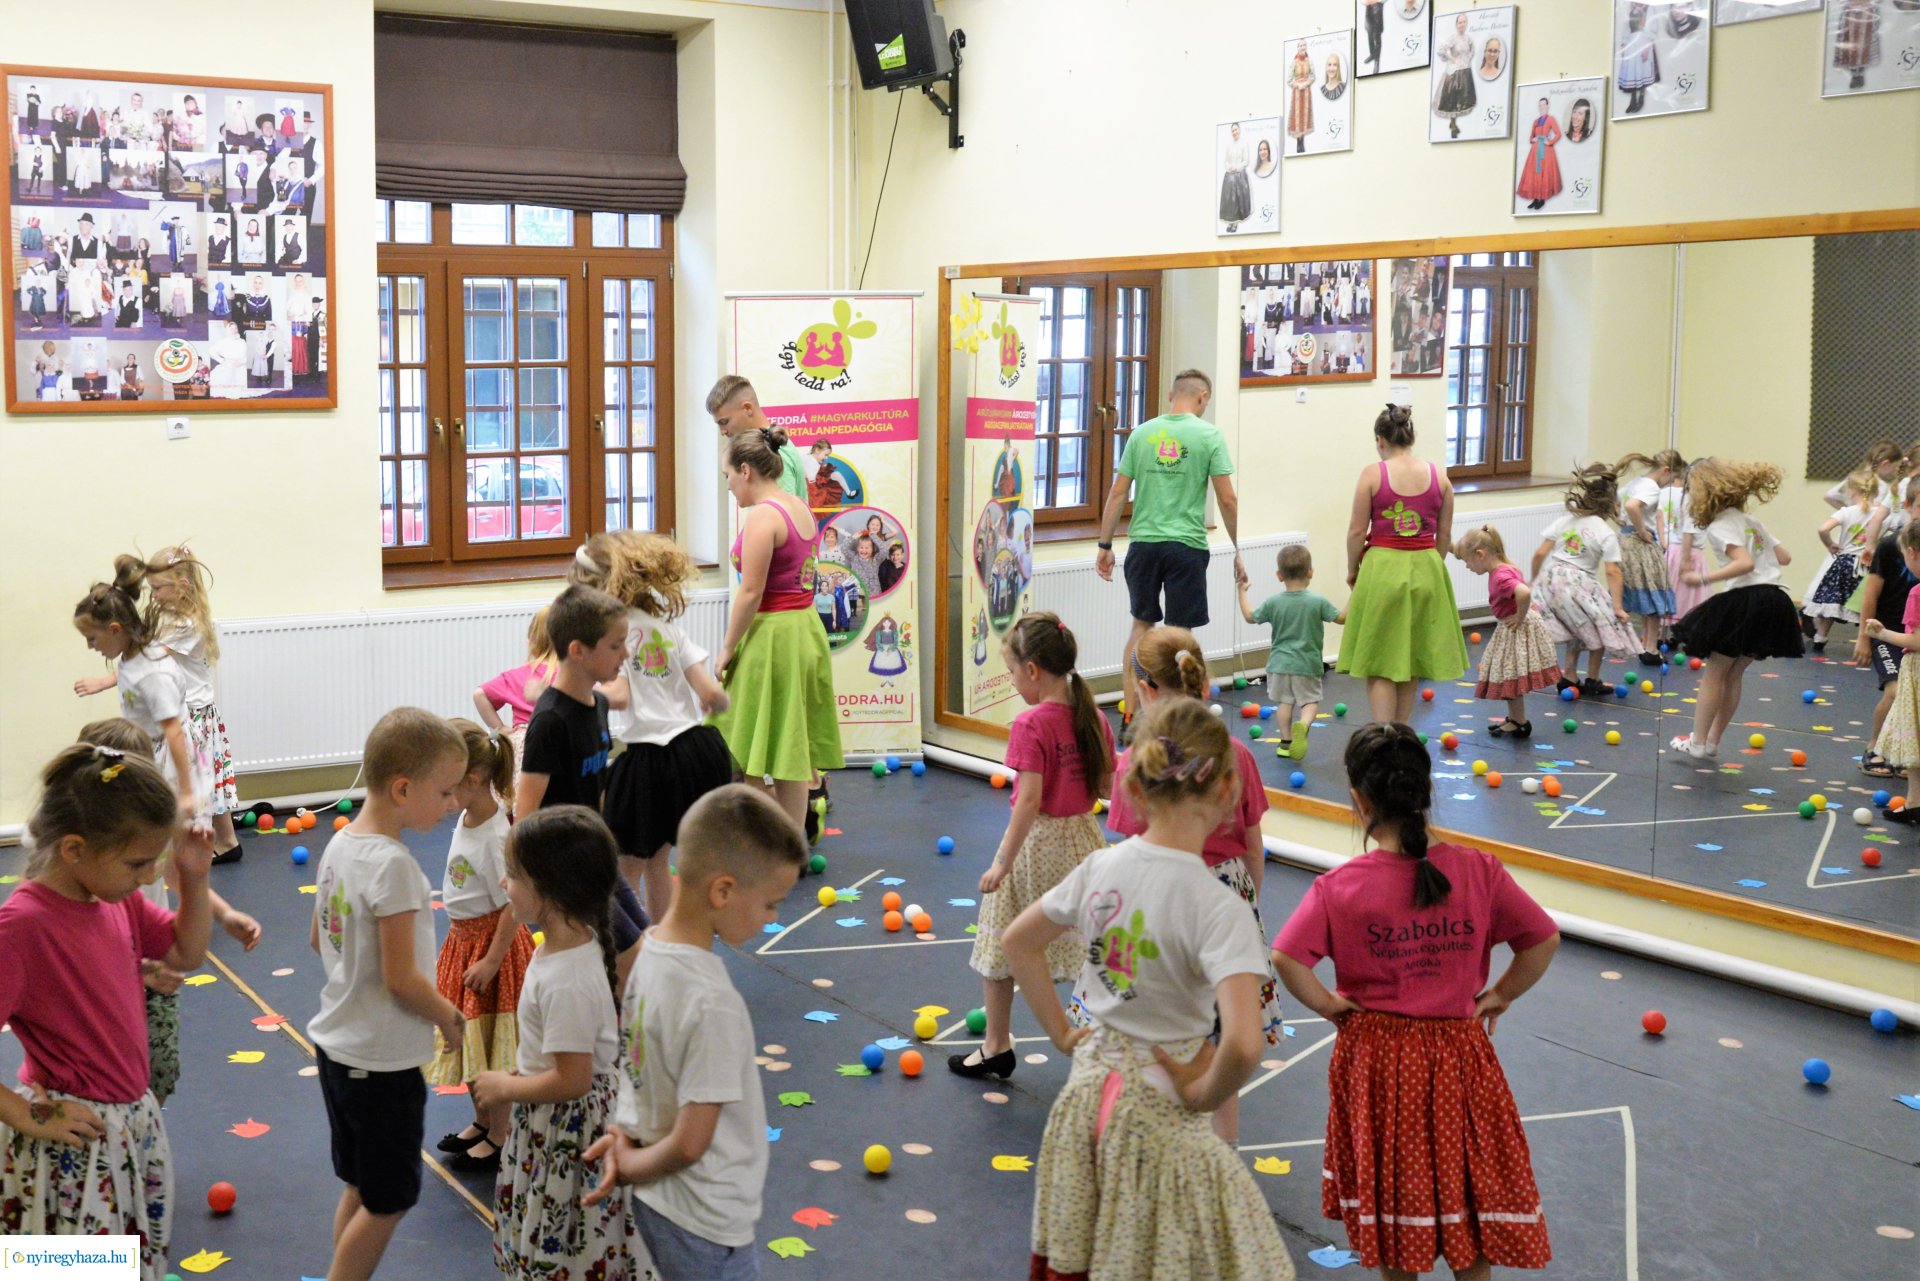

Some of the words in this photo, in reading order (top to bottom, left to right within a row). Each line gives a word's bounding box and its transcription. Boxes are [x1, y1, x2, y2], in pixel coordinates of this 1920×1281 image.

[794, 371, 826, 391] tedd
[810, 408, 910, 424] #MAGYARKULTÚRA
[834, 693, 904, 706] DDRA.HU
[1367, 916, 1475, 944] Szabolcs
